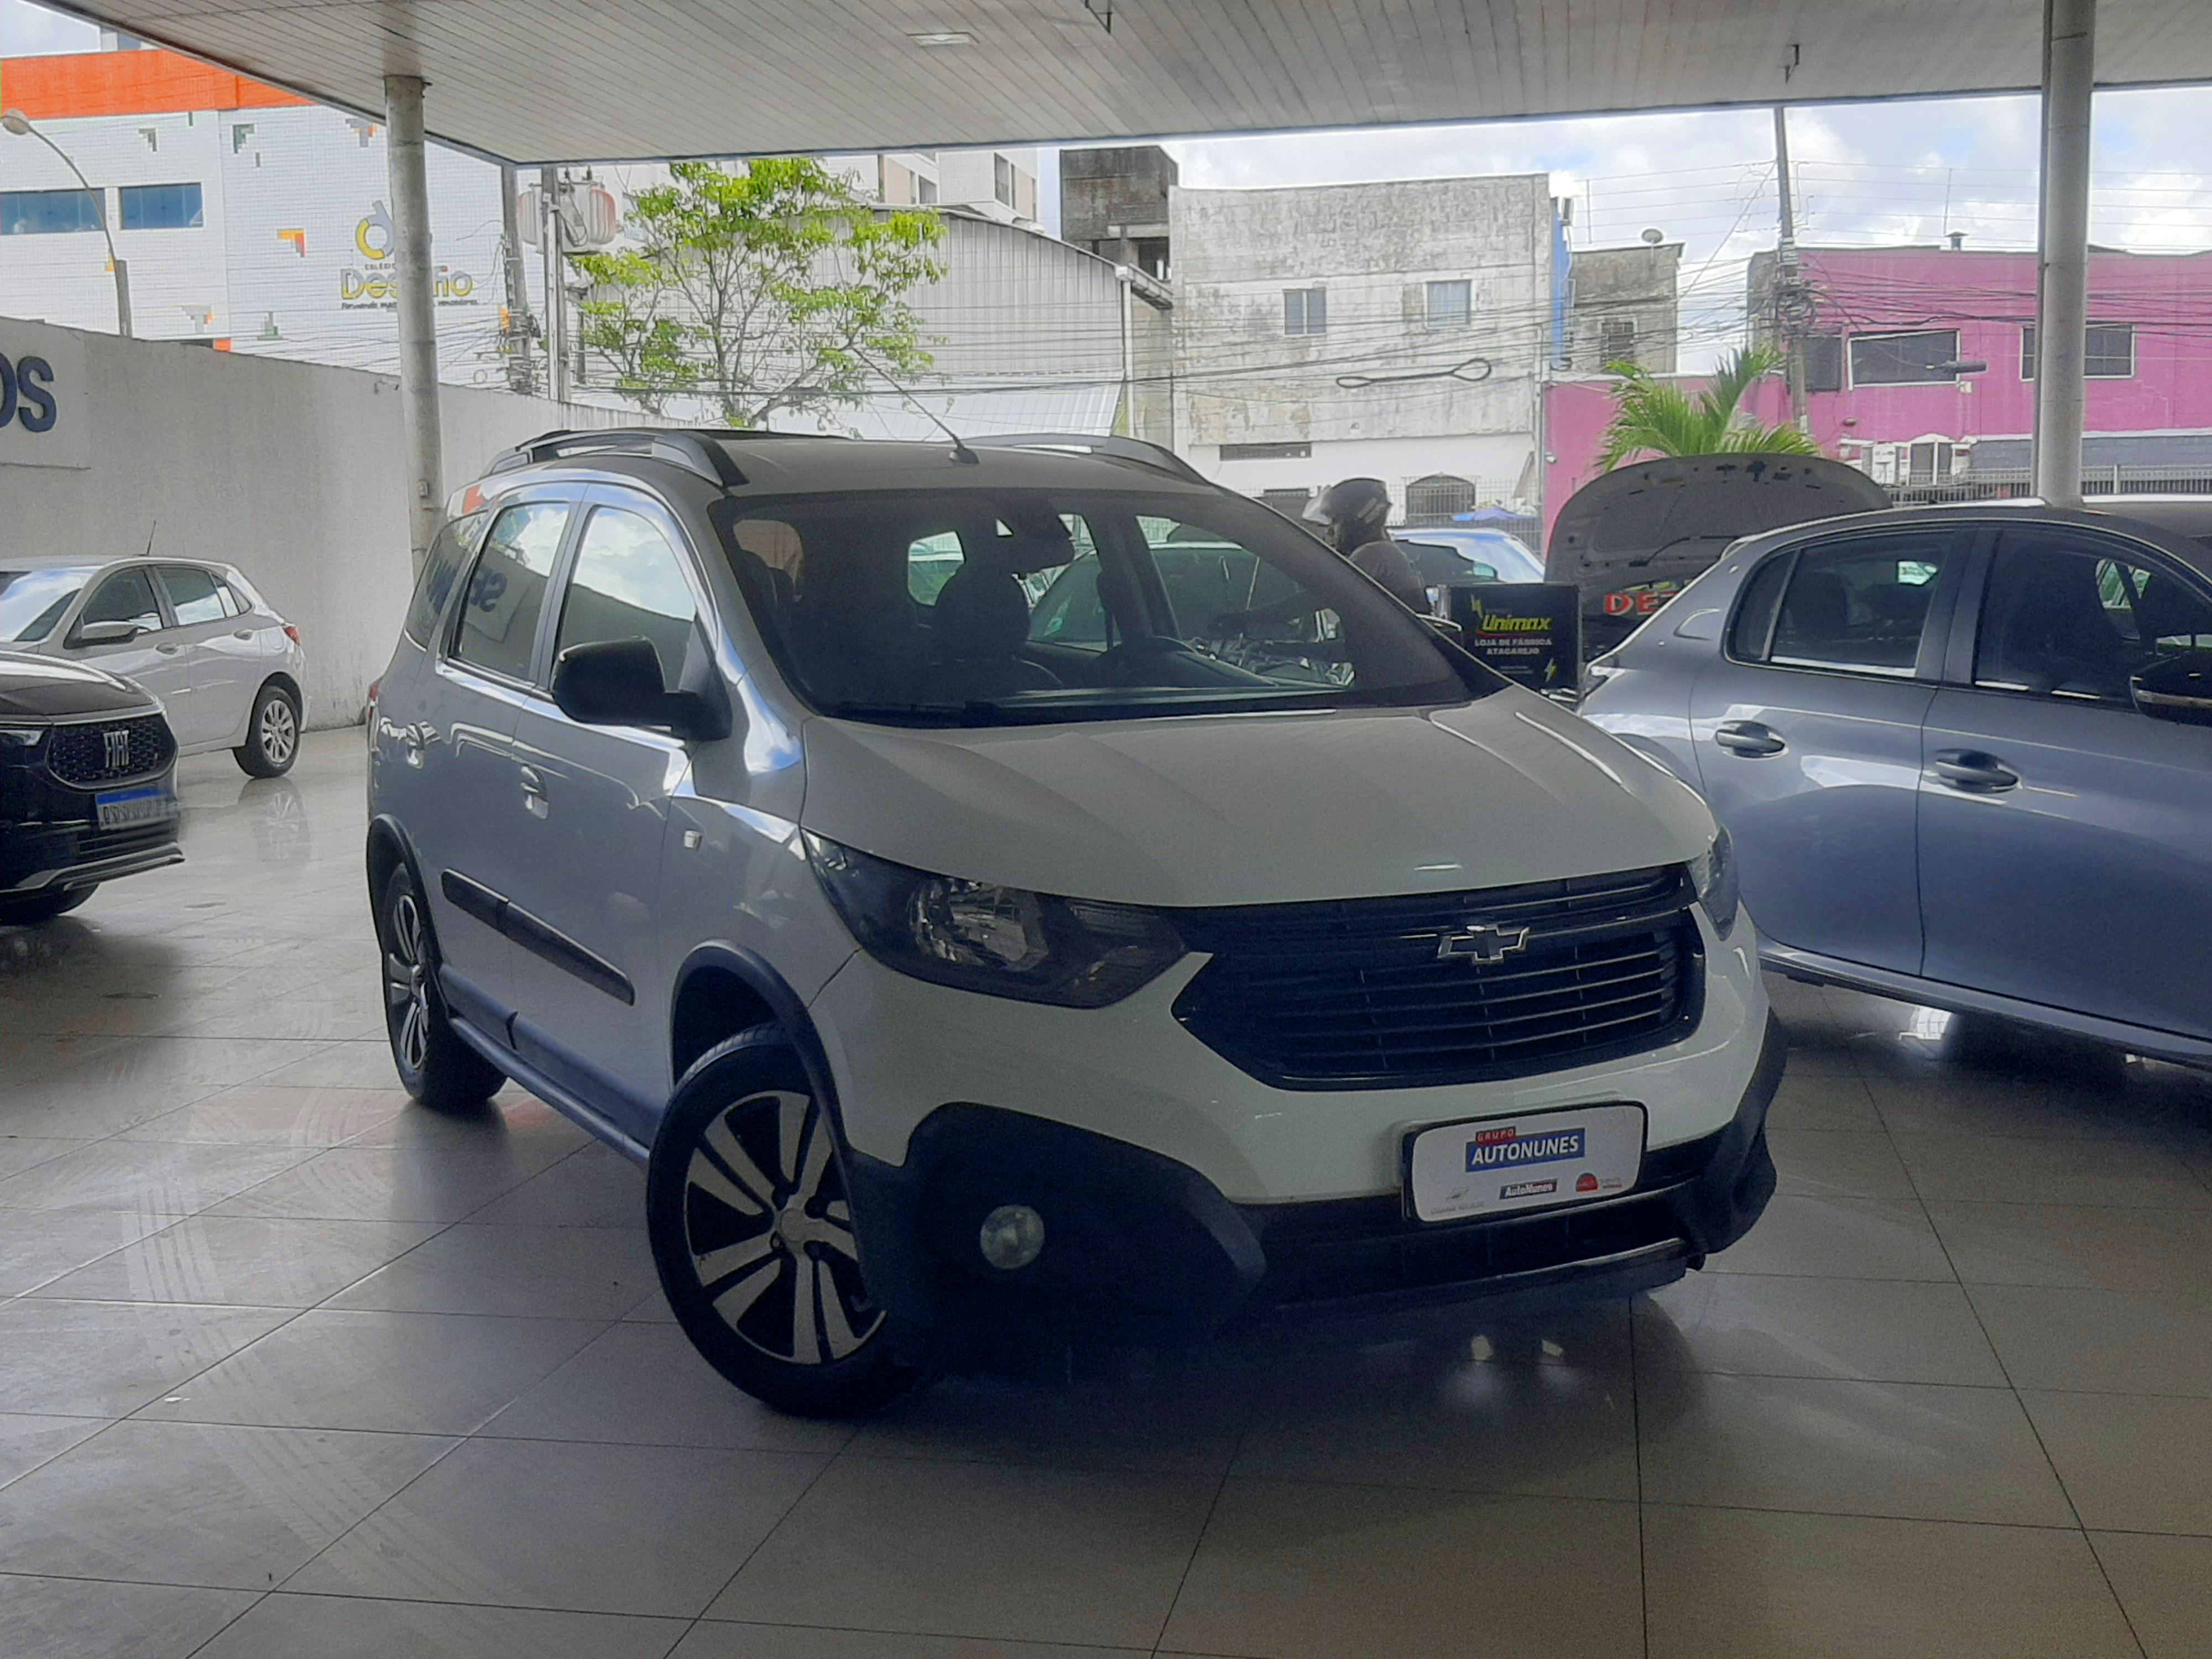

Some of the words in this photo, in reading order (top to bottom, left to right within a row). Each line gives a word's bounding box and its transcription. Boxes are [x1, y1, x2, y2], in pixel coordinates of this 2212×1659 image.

[340, 265, 473, 300] Desfio
[1604, 590, 1679, 616] DE
[1483, 614, 1553, 631] Unimax
[103, 730, 129, 769] FIAT
[1477, 1129, 1515, 1141] GRUPO
[1472, 1135, 1579, 1165] AUTONUNES
